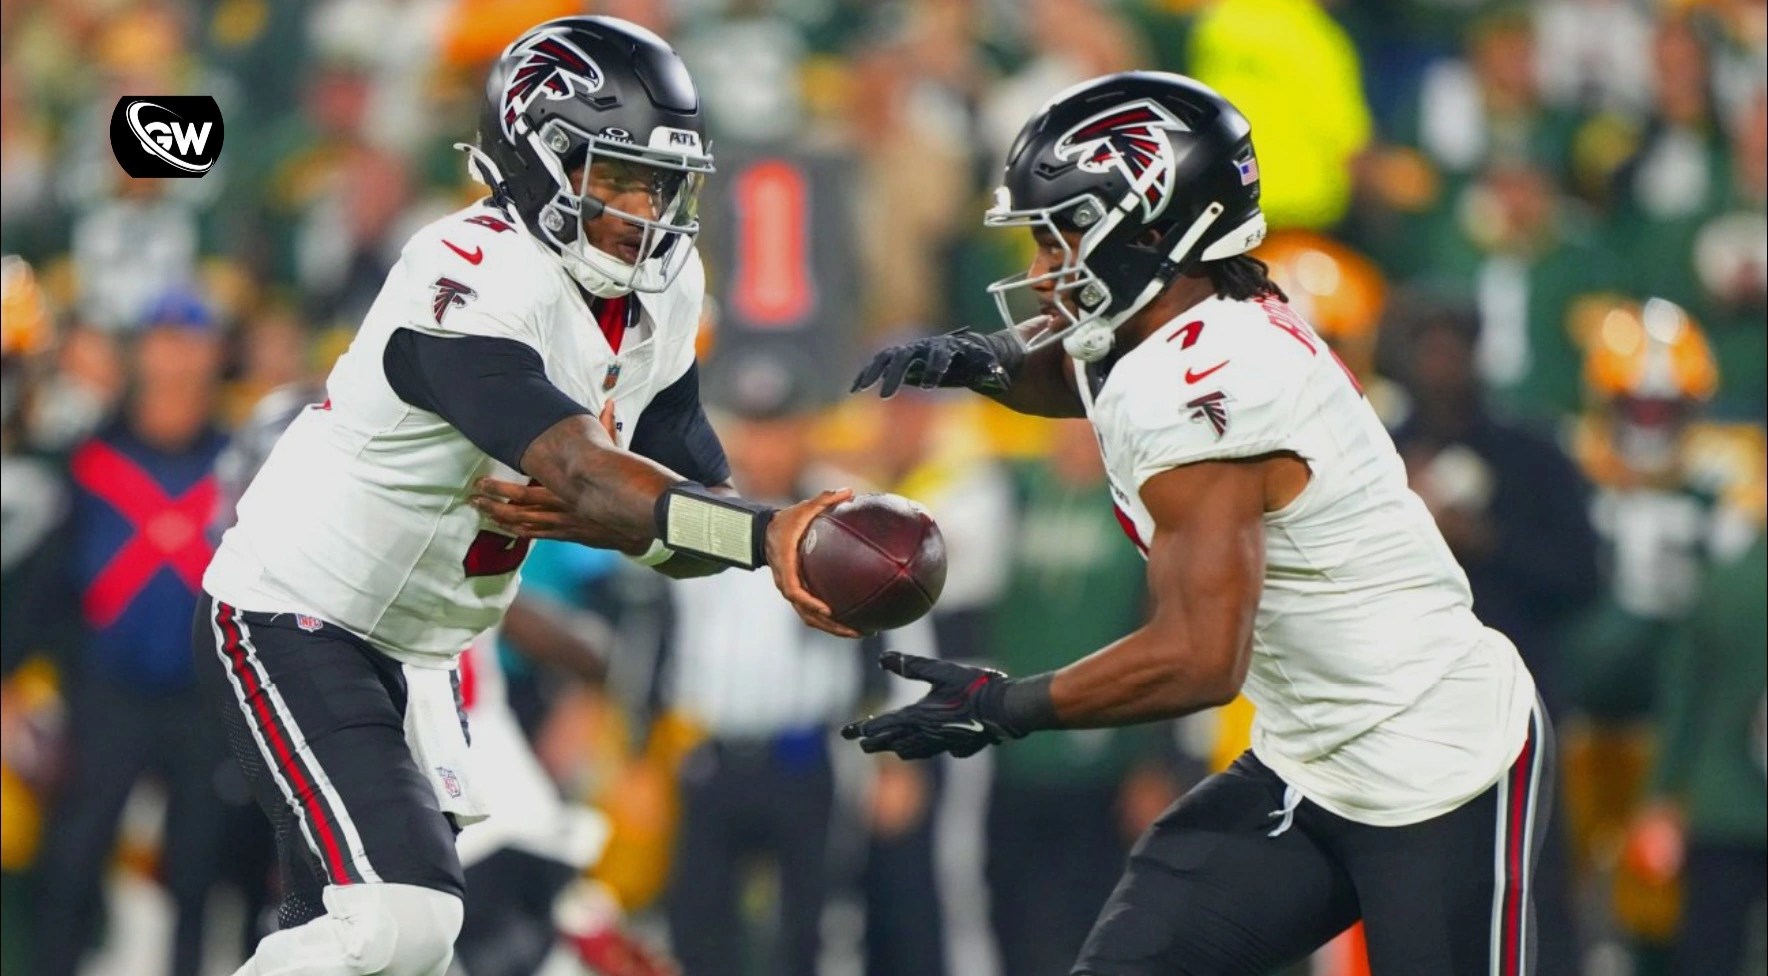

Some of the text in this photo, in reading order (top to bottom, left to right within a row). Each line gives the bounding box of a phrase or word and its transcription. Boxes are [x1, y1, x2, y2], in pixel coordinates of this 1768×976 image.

[668, 131, 696, 147] ATL
[735, 160, 813, 326] 1
[1166, 320, 1205, 350] 7
